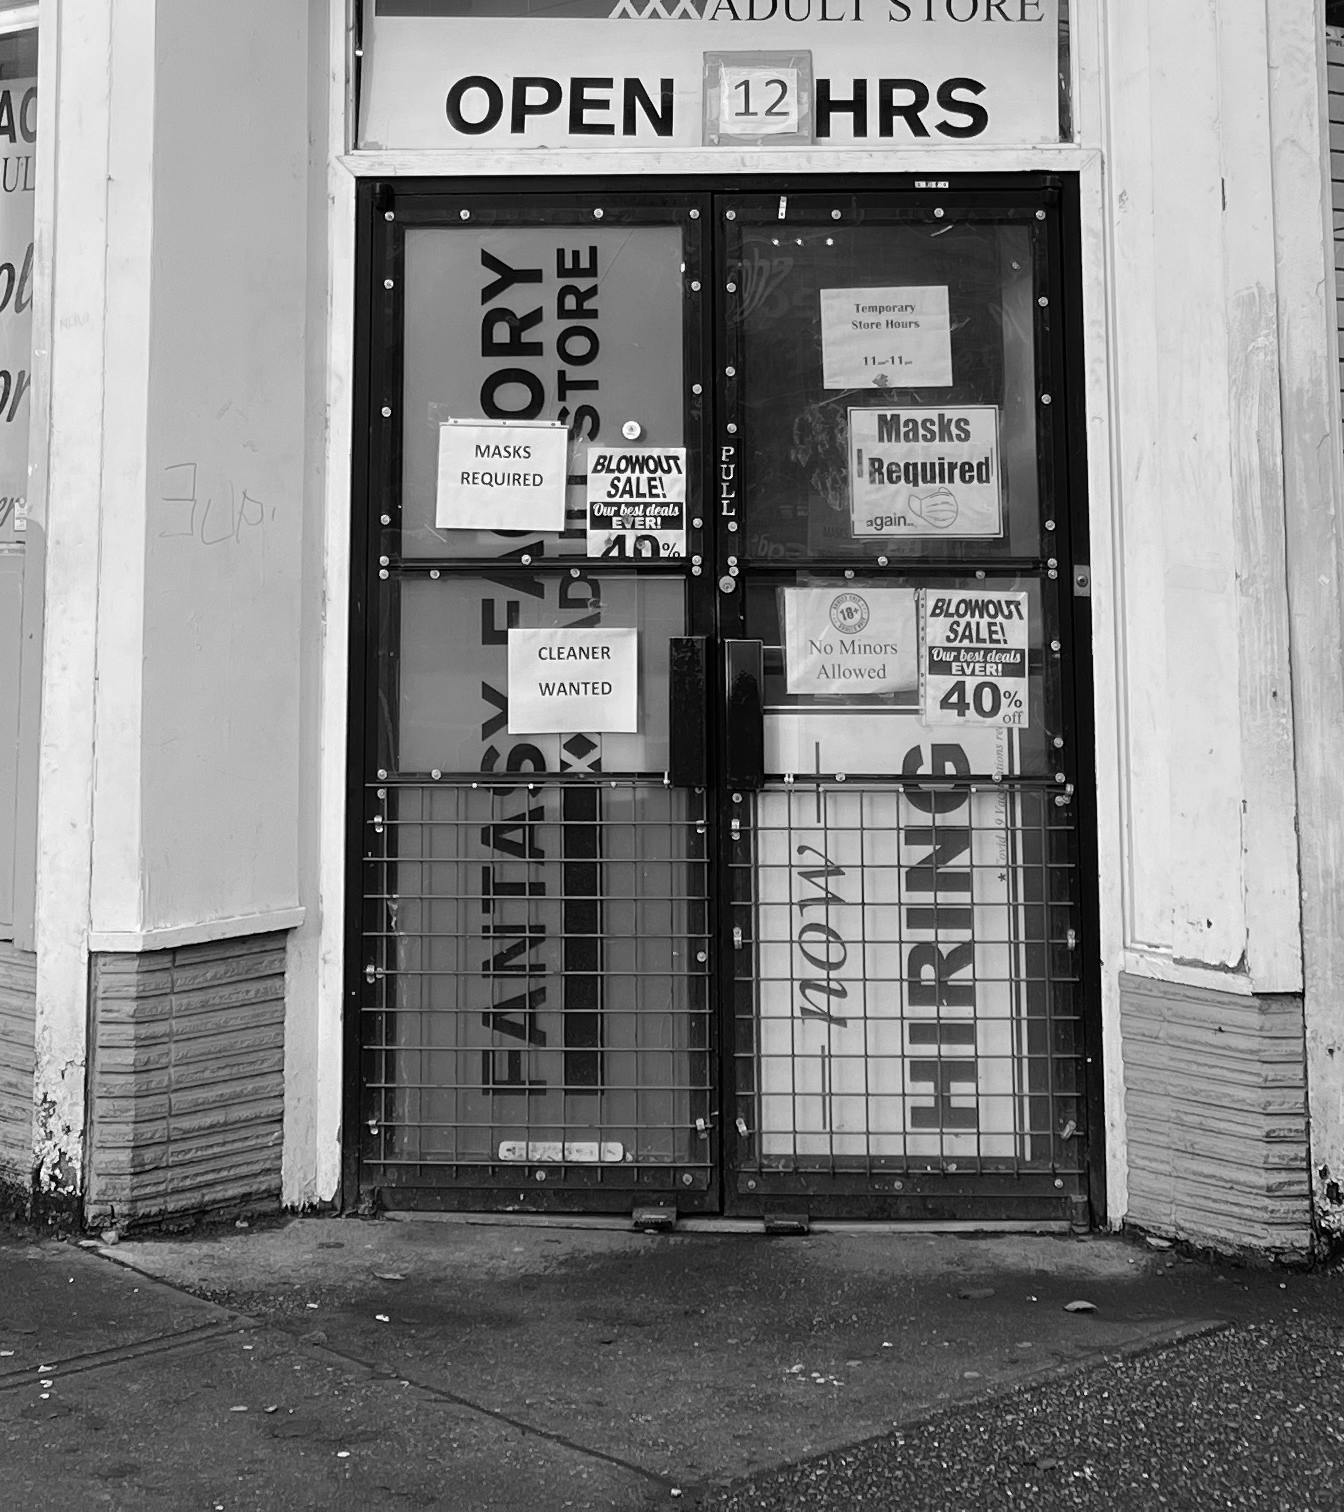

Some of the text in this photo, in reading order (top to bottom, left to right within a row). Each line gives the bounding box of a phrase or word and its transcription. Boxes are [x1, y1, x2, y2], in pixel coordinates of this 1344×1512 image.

[444, 74, 990, 139] OPEN 12 HRS
[854, 303, 916, 315] Temporary
[851, 319, 921, 330] Store Hours
[877, 413, 971, 444] Masks
[474, 444, 532, 460] MASKS
[591, 454, 683, 475] BLOWOUT
[868, 456, 991, 487] Required
[460, 471, 544, 487] REQUIRED
[721, 446, 735, 516] PULL
[606, 476, 667, 499] SALE!
[592, 502, 680, 517] Our best deals
[611, 516, 662, 529] EVER!
[839, 604, 860, 622] 18+
[929, 598, 1025, 620] BLOWOUT
[945, 621, 1008, 645] SALE!
[538, 646, 612, 661] CLEANER
[808, 638, 898, 655] No Minors
[931, 647, 1021, 663] Our best deals
[816, 663, 888, 679] Allowed
[951, 663, 1003, 677] EVER!
[538, 681, 613, 696] WANTED
[1002, 710, 1024, 725] off
[796, 845, 848, 1029] now
[901, 743, 978, 1130] HIRING
